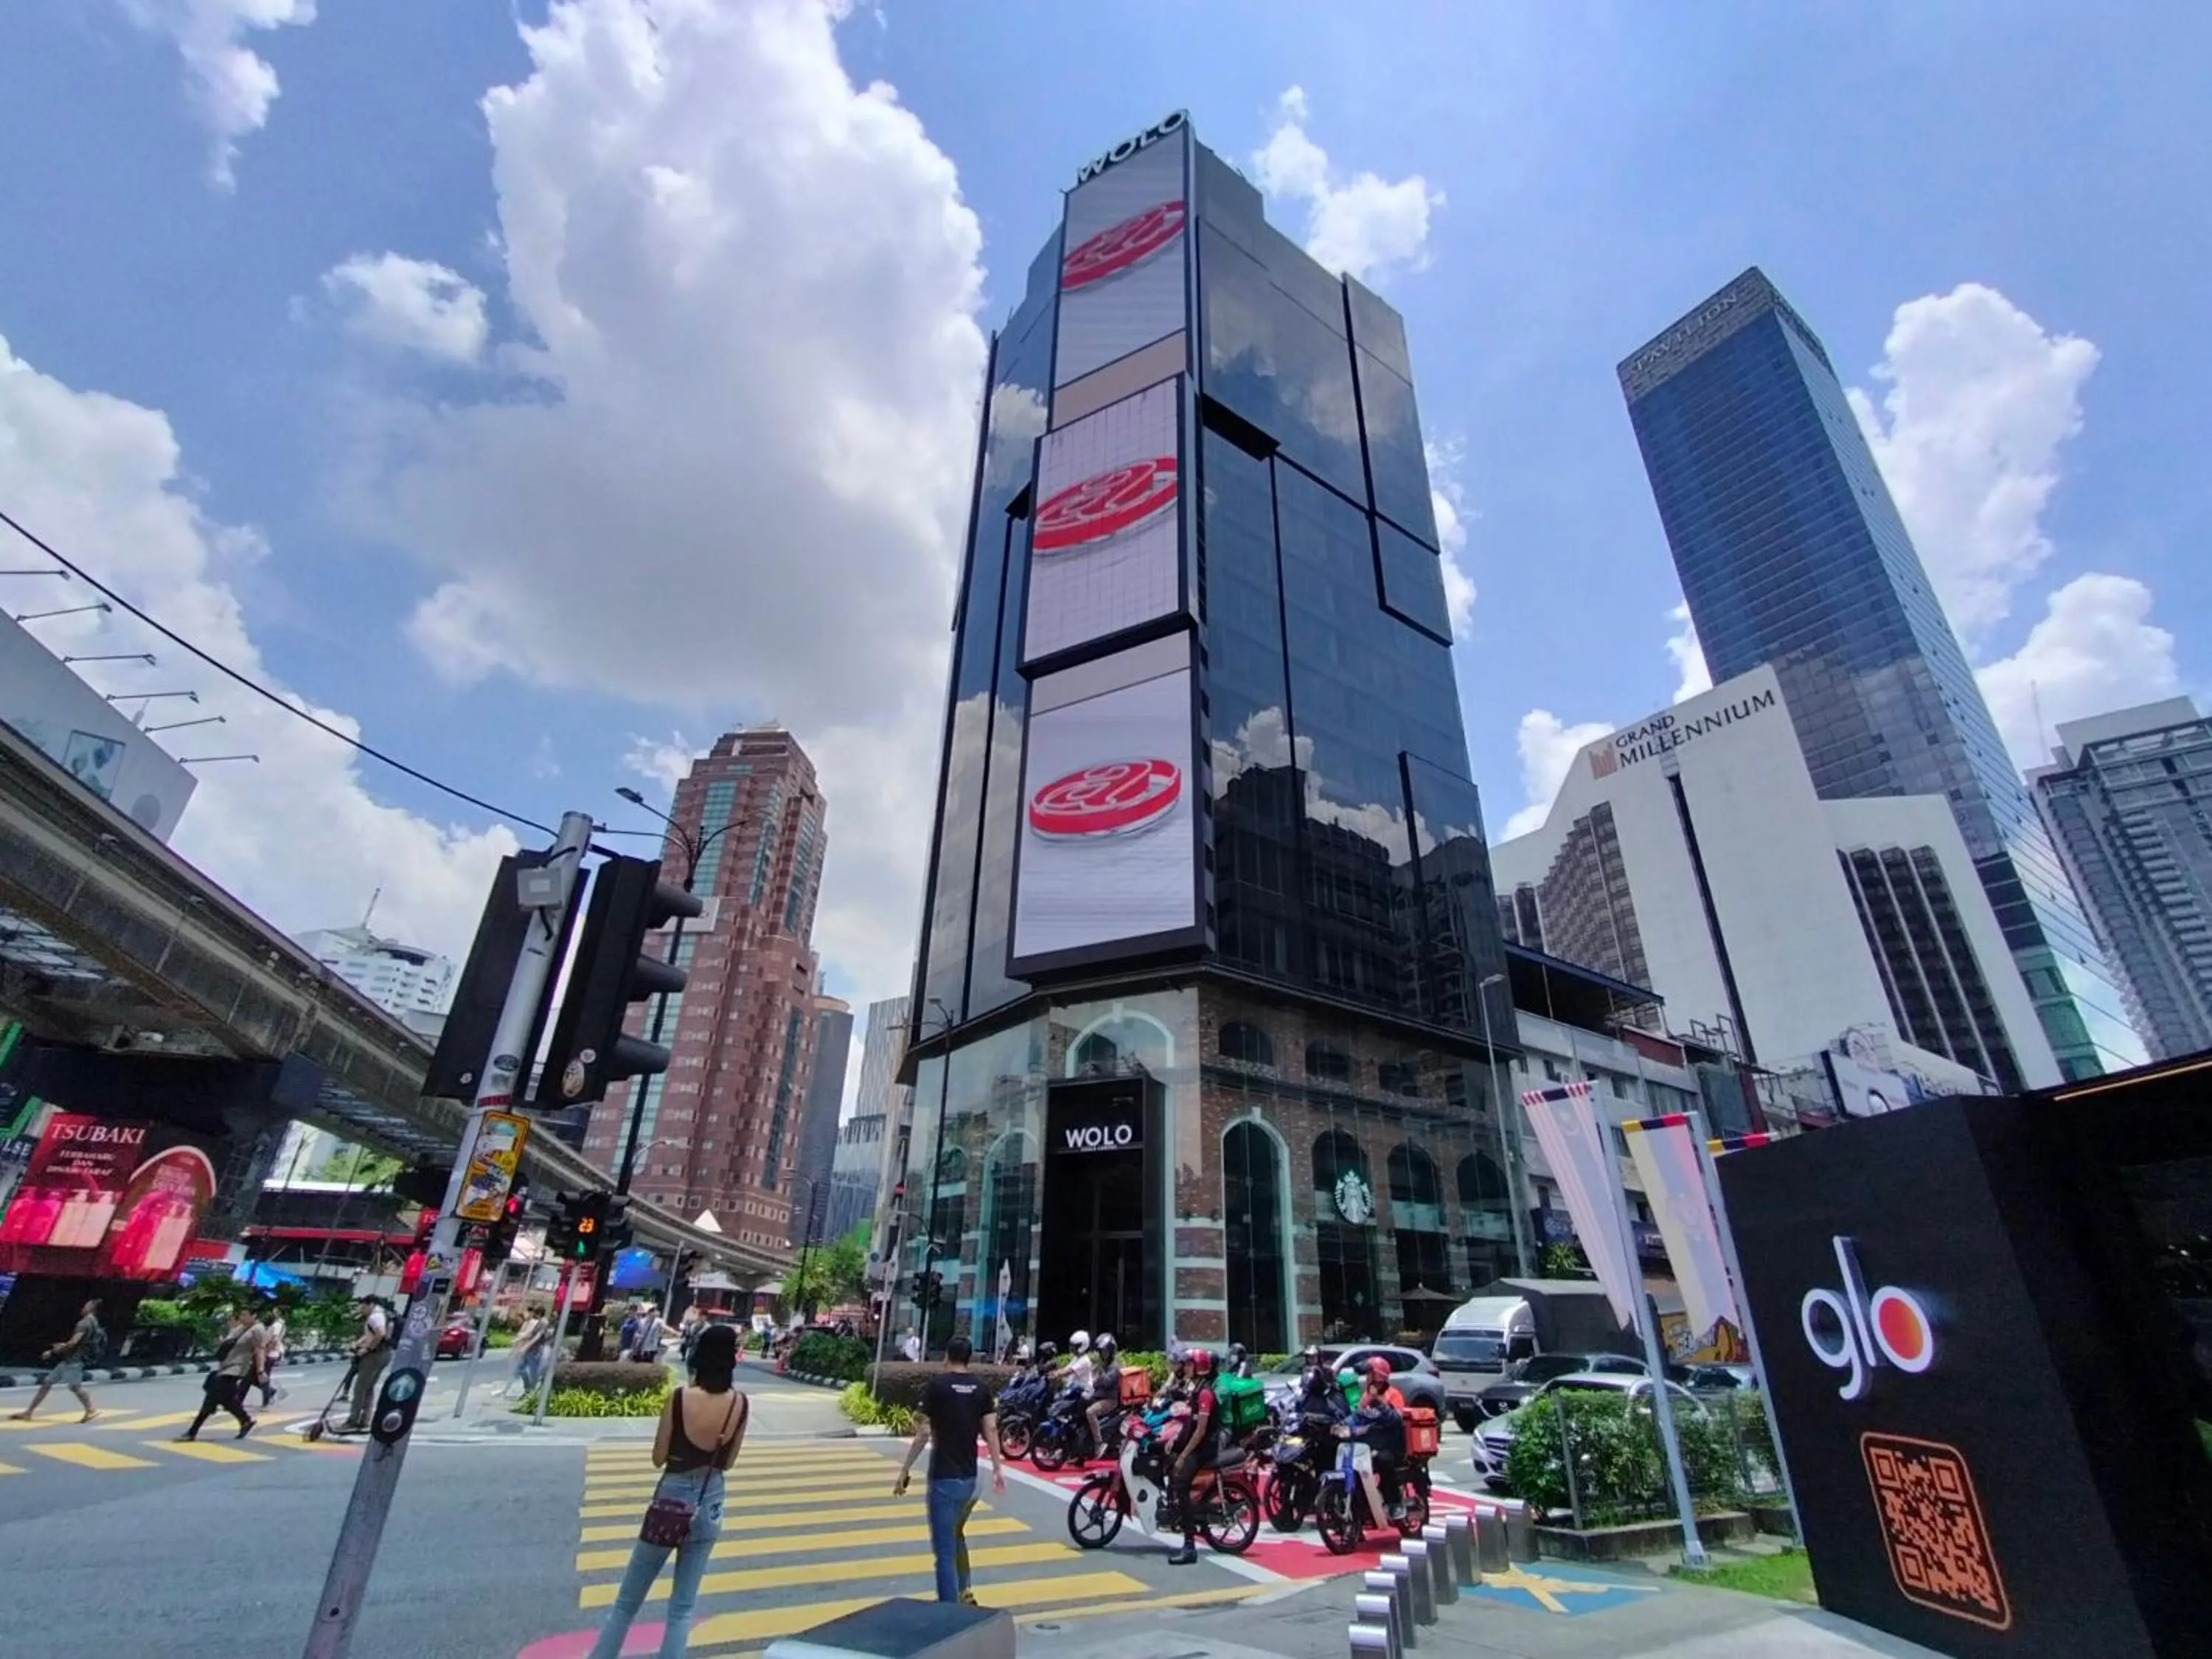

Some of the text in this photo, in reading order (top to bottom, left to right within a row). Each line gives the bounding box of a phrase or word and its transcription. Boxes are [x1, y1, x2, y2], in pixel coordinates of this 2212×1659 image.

[1077, 108, 1187, 183] WOLO
[1632, 291, 1738, 370] PAVILION
[1615, 714, 1675, 748] GRAND
[1619, 689, 1775, 768] MILLENNIUM
[50, 1123, 146, 1144] TSUBAKI
[1065, 1124, 1133, 1149] WOLO
[1801, 1235, 1933, 1400] glo
